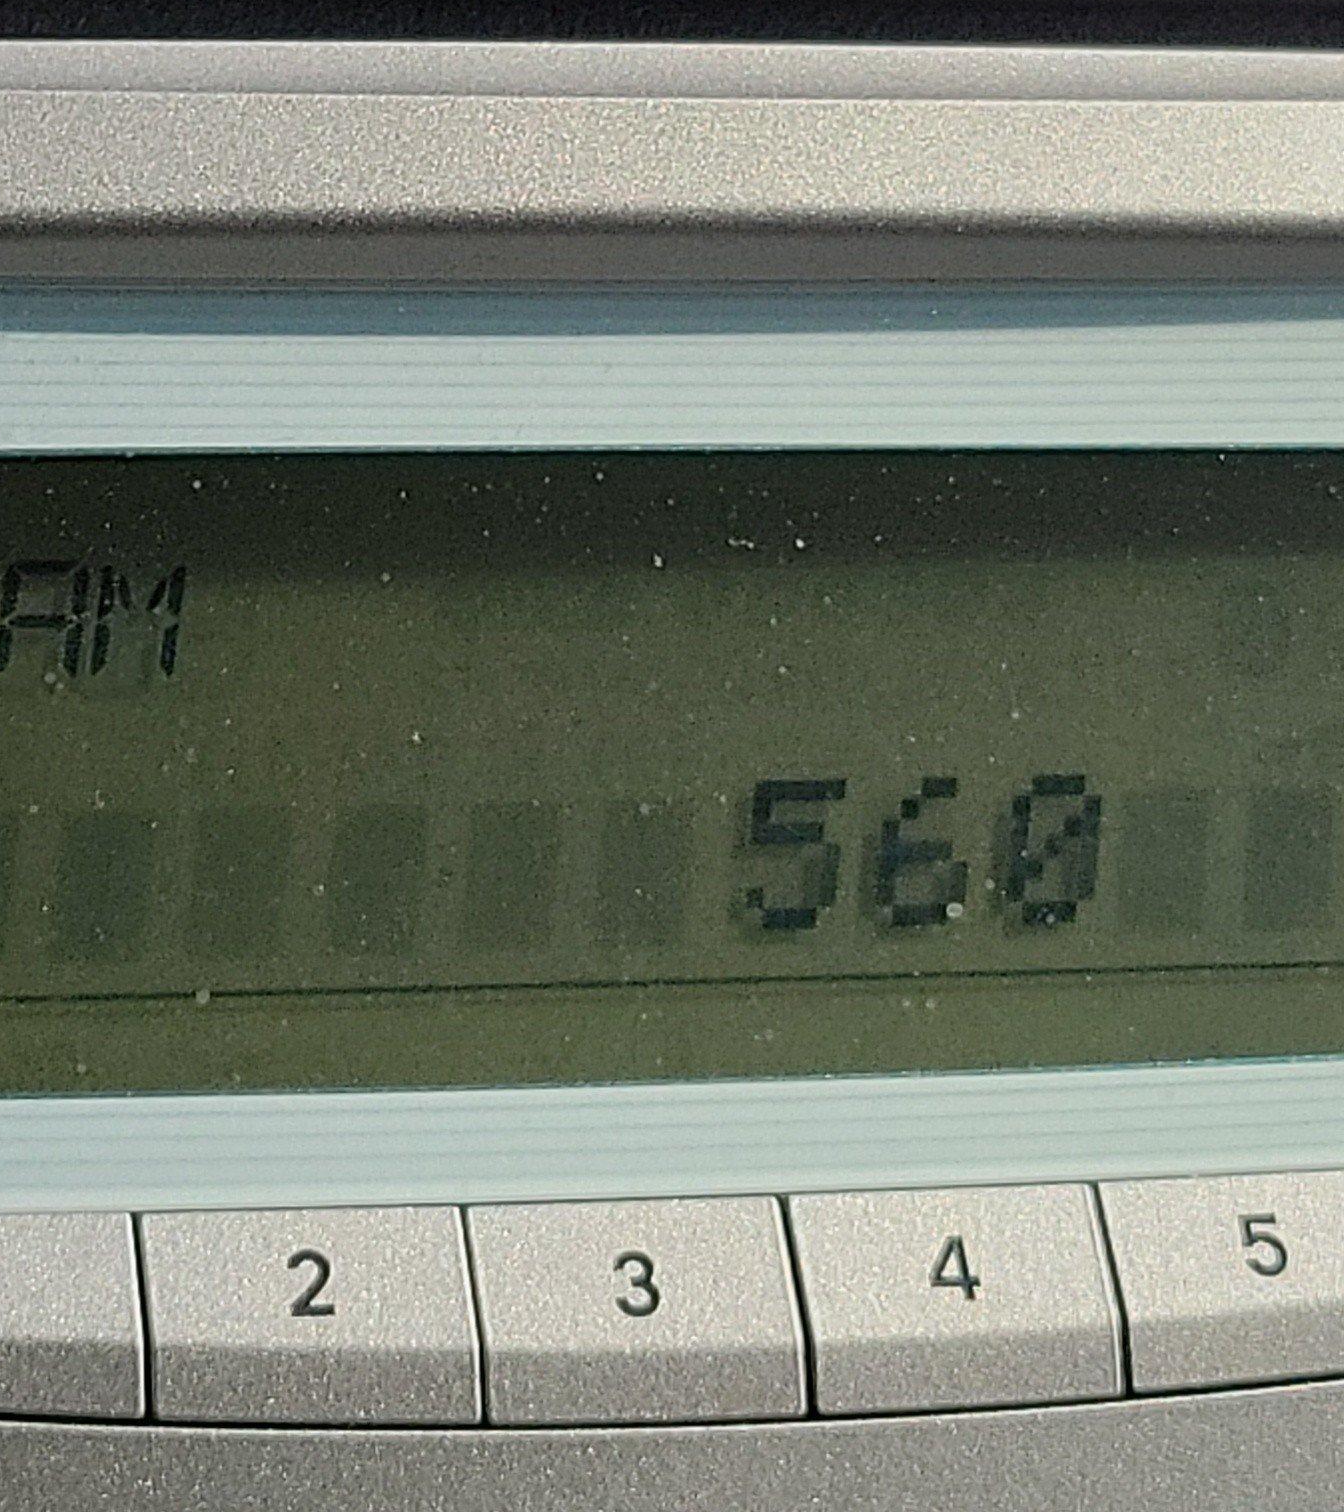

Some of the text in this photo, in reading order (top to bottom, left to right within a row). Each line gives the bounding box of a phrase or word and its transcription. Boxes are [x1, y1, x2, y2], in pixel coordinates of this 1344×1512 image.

[746, 774, 1102, 931] 560
[929, 1235, 981, 1301] 4
[1239, 1212, 1288, 1277] 5
[286, 1248, 336, 1317] 2
[613, 1249, 662, 1317] 3
